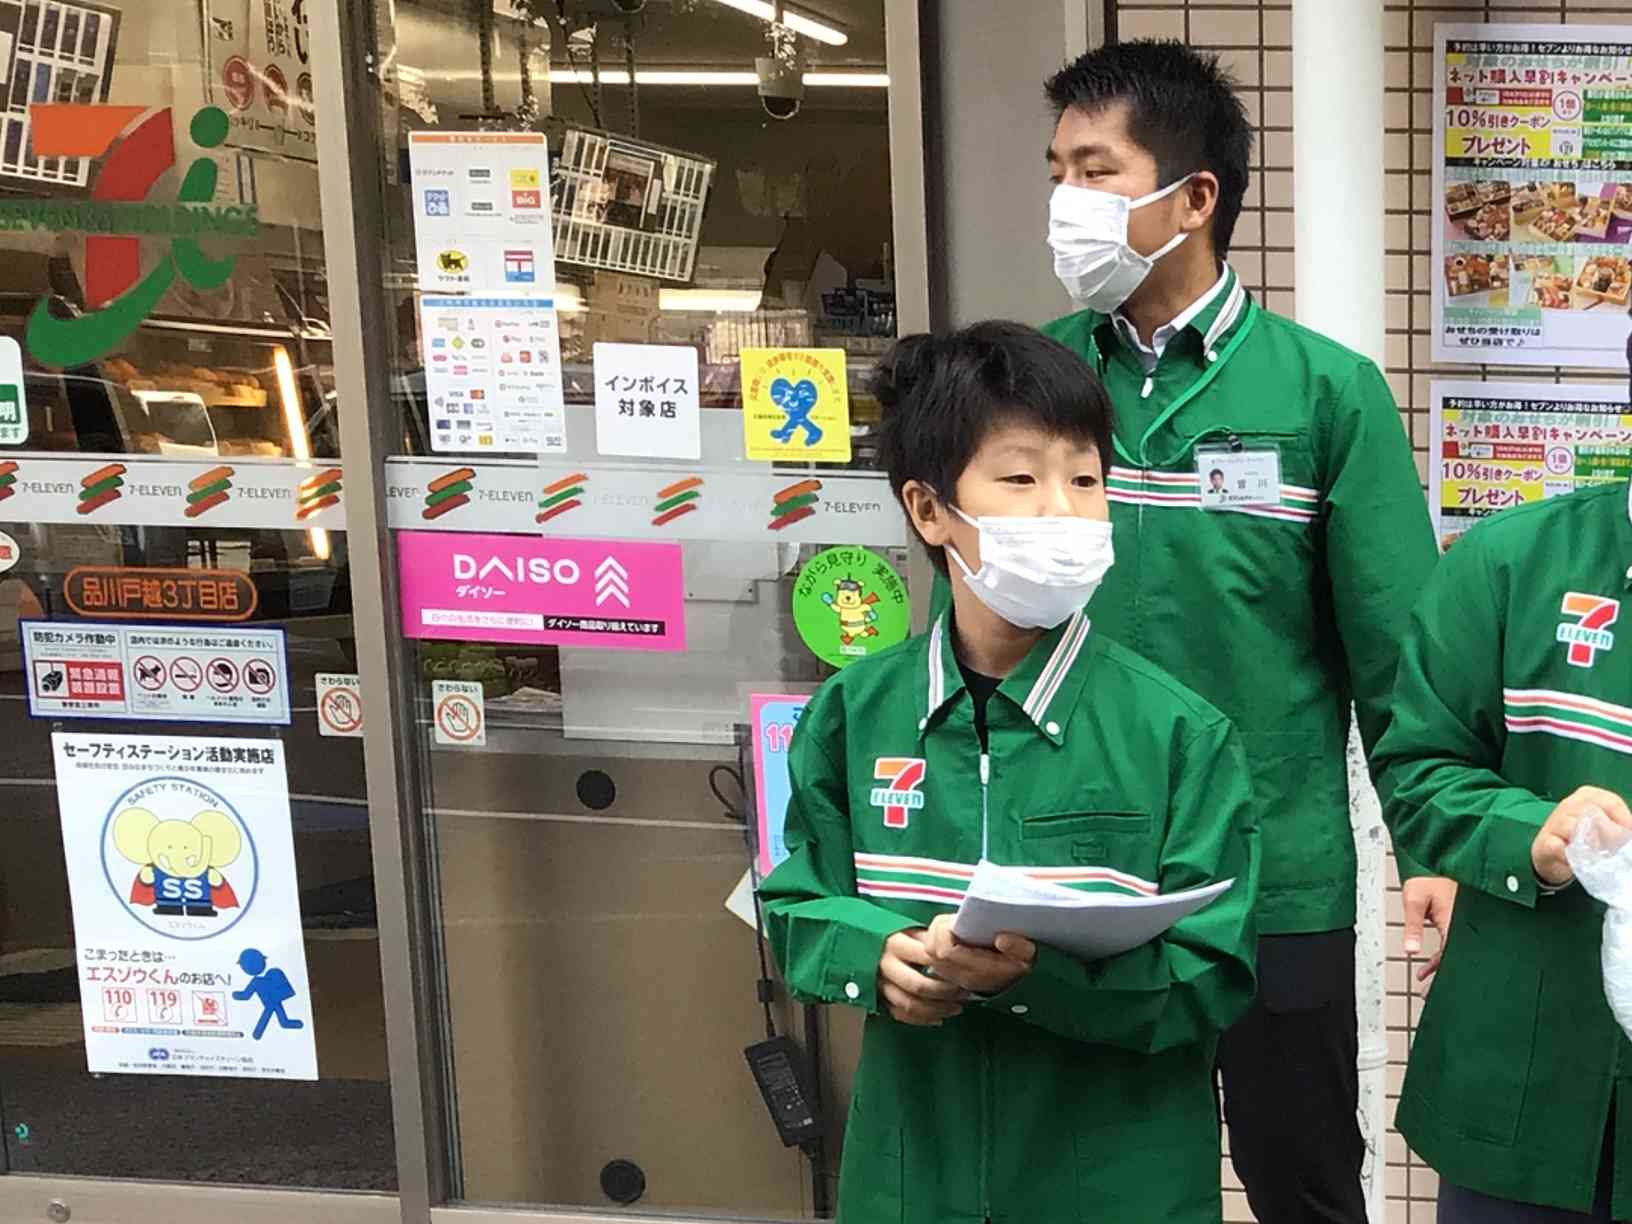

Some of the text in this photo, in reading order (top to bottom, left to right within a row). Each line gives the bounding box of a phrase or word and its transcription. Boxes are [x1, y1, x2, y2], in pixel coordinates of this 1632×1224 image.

[1462, 136, 1530, 155] プレゼント
[604, 375, 690, 396] インボイス
[617, 398, 678, 419] 対象店
[1445, 424, 1632, 441] ネット購入早割キャンペーン
[1458, 489, 1524, 506] プレゼント
[453, 553, 580, 584] DAISO
[799, 551, 867, 597] ながら見守り
[455, 584, 506, 599] ダイソー
[33, 631, 117, 646] 防犯カメラ作動中
[438, 683, 479, 693] さわらない
[63, 741, 275, 765] セーフティステーション活動実施店
[127, 783, 219, 808] SAFETY STATION
[162, 878, 205, 901] SS
[104, 989, 177, 1008] 110 119
